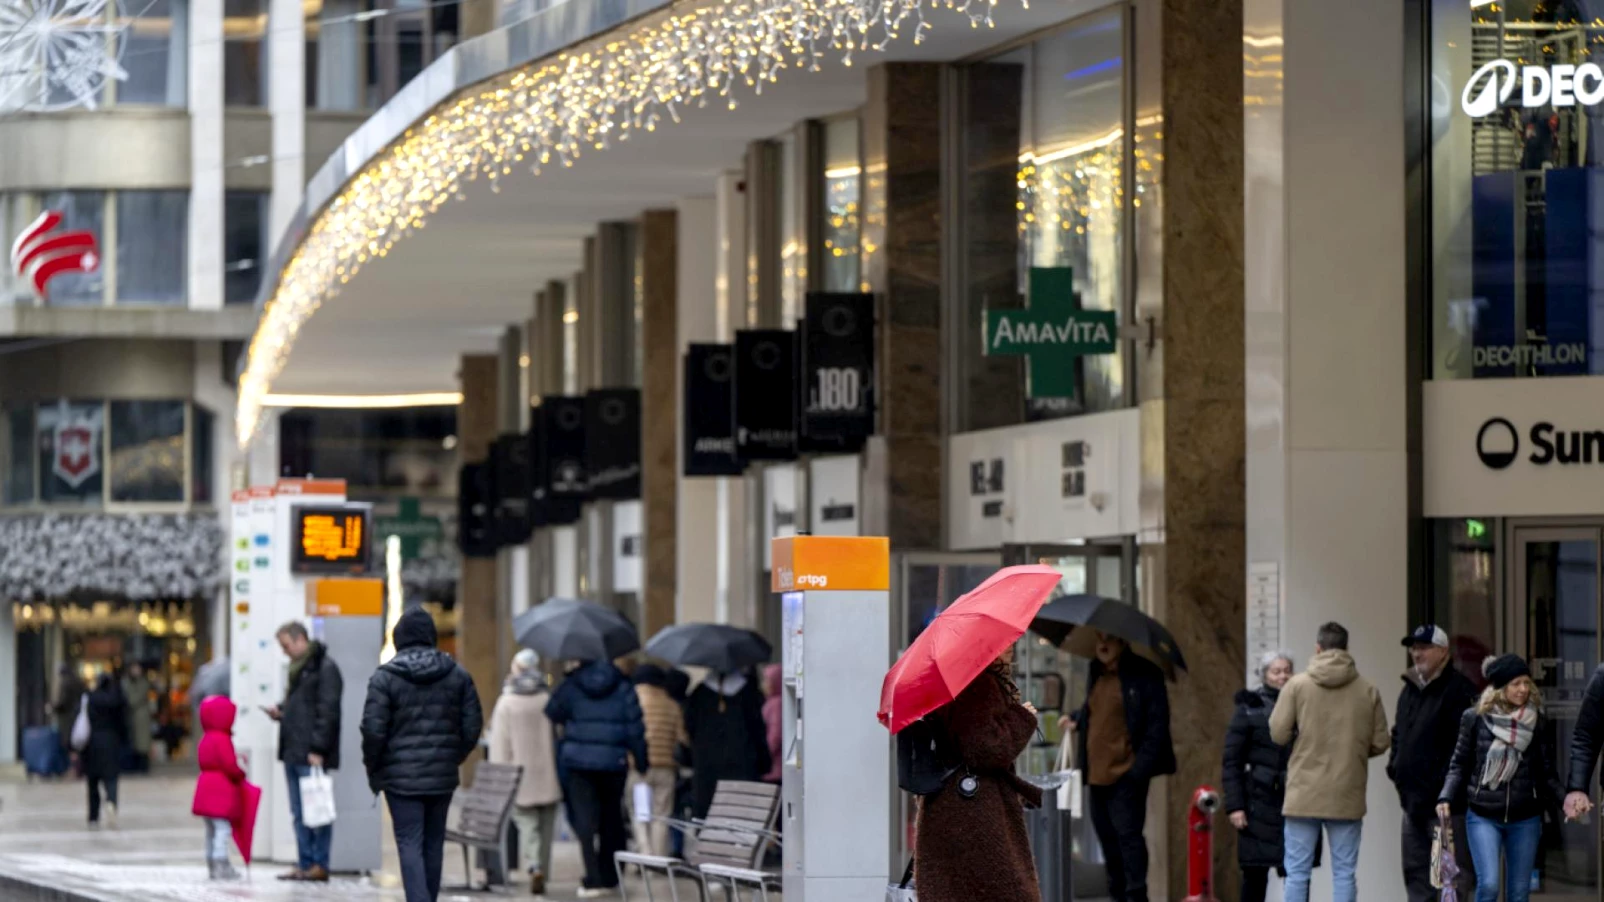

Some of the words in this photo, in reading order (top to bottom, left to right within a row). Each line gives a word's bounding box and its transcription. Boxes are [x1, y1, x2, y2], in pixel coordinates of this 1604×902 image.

[992, 316, 1111, 348] AMAVITA
[1473, 342, 1586, 367] DECATHLON
[816, 367, 859, 411] 180
[1529, 421, 1604, 465] Sun
